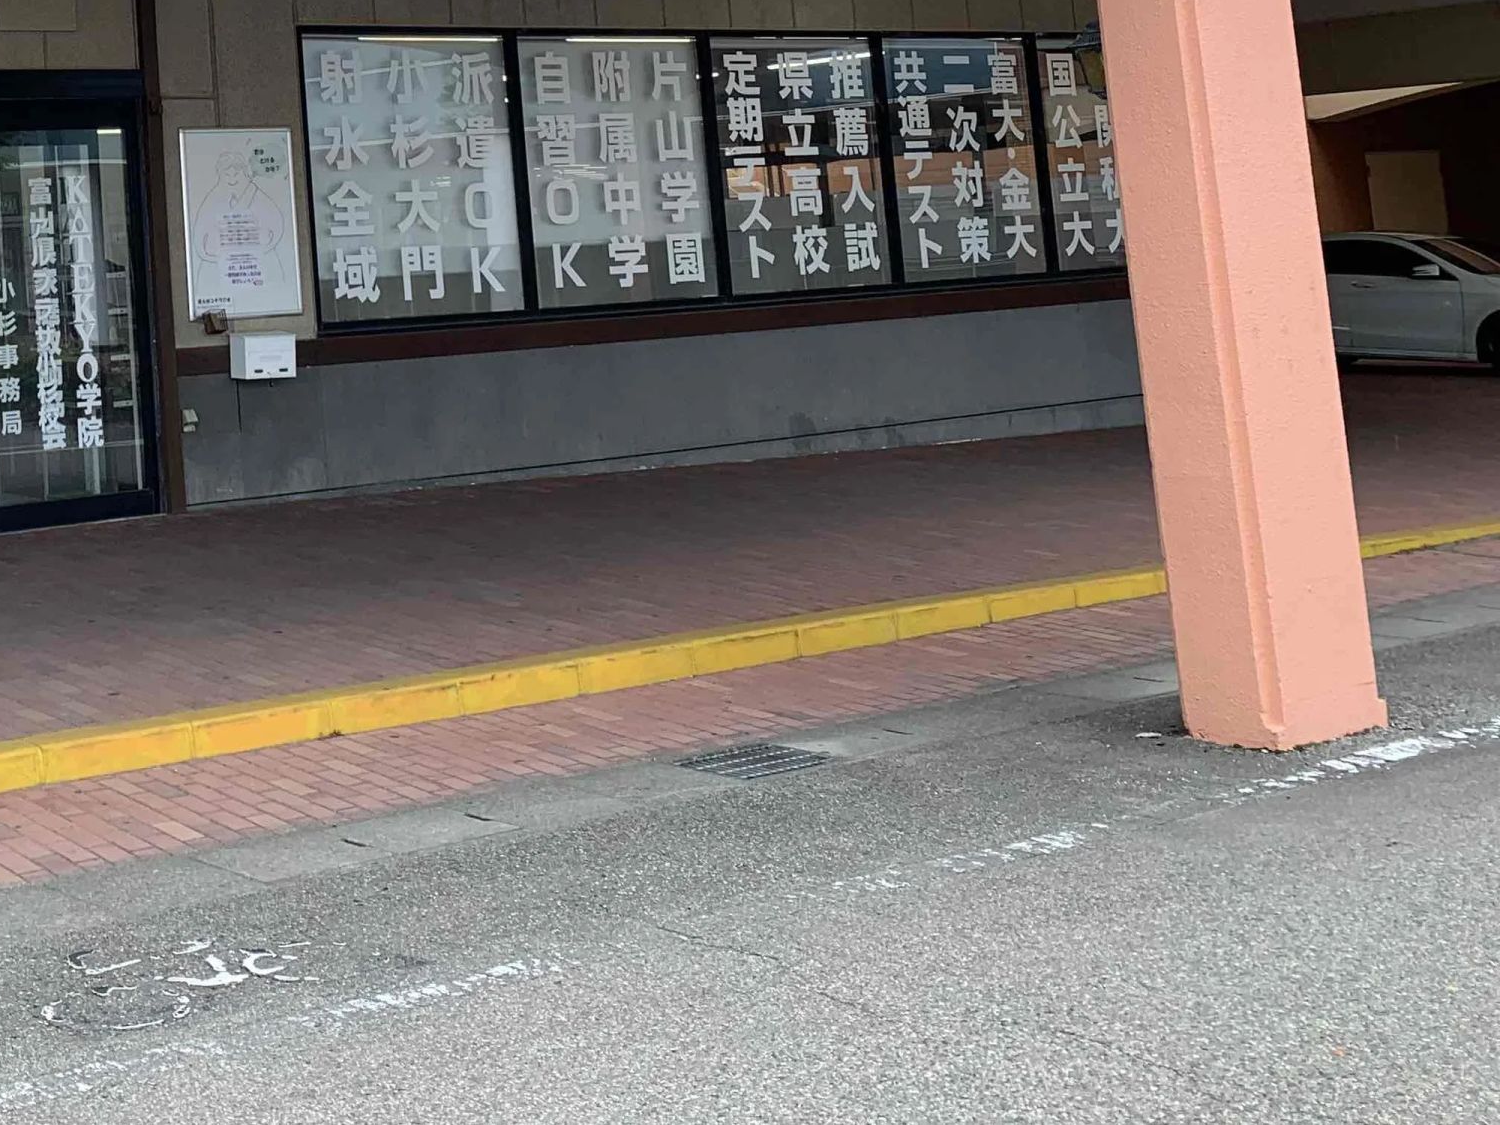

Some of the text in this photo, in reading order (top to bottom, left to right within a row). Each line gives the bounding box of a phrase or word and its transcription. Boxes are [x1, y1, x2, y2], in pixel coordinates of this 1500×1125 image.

[320, 50, 381, 303] 射水全域
[387, 49, 446, 301] 小杉大門
[451, 51, 506, 293] 派遣OK
[534, 51, 587, 289] 自習OK
[592, 51, 649, 288] 附属中学
[652, 50, 706, 285] 片山学園
[722, 51, 776, 279] 定期テスト
[776, 51, 830, 276] 県立高校
[828, 51, 881, 272] 推薦入試
[894, 51, 943, 268] 共通テスト
[943, 54, 992, 264] 二次対策
[1046, 53, 1095, 256] 国公立大
[65, 175, 105, 449] KATEKYO学院
